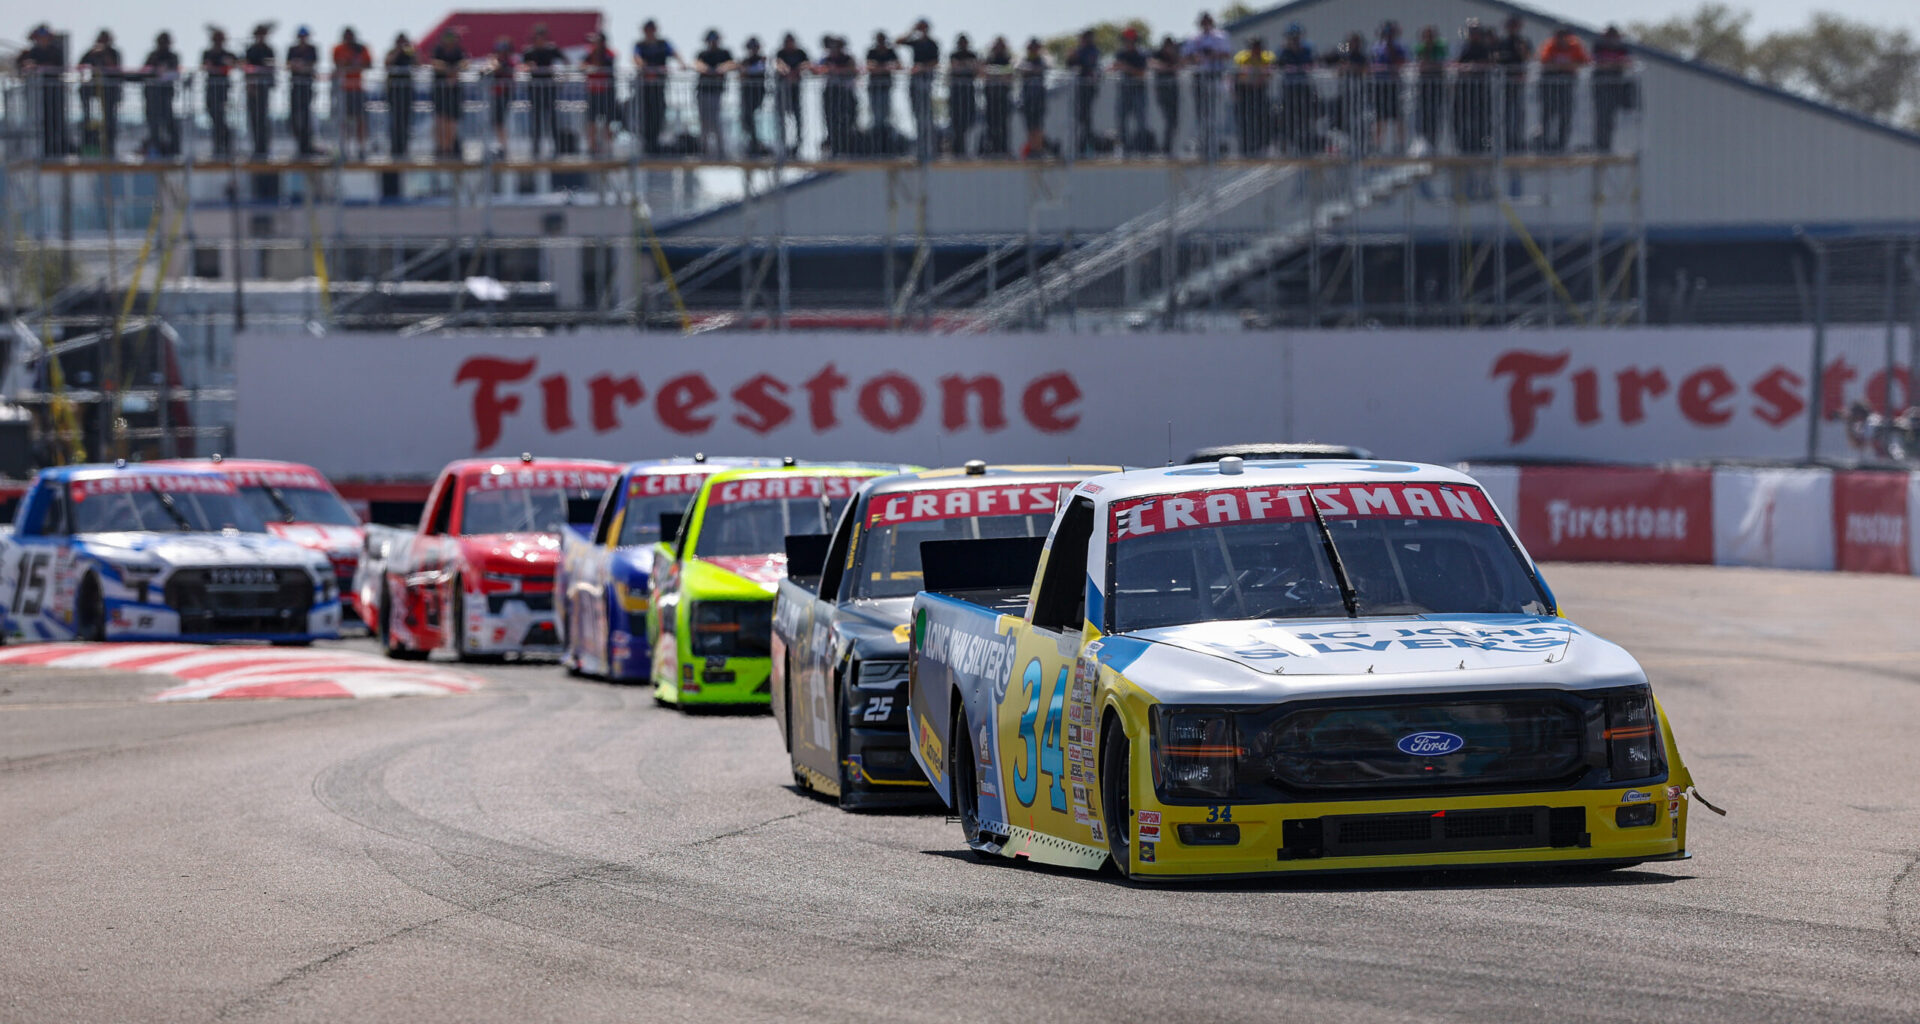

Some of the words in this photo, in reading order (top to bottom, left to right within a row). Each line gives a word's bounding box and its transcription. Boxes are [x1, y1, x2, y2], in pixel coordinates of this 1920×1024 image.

[454, 354, 1082, 453] Firestone
[1123, 487, 1482, 536] CRAFTSMAN
[1547, 498, 1688, 545] Firestone
[11, 551, 48, 616] 15
[210, 569, 276, 584] TOYOTA
[926, 620, 949, 664] LONG
[963, 634, 1015, 697] SILVER'S
[863, 696, 893, 722] 25
[1013, 656, 1069, 814] 34
[1410, 734, 1450, 752] Ford
[1140, 811, 1159, 824] SIMPSON
[1206, 804, 1232, 823] 34
